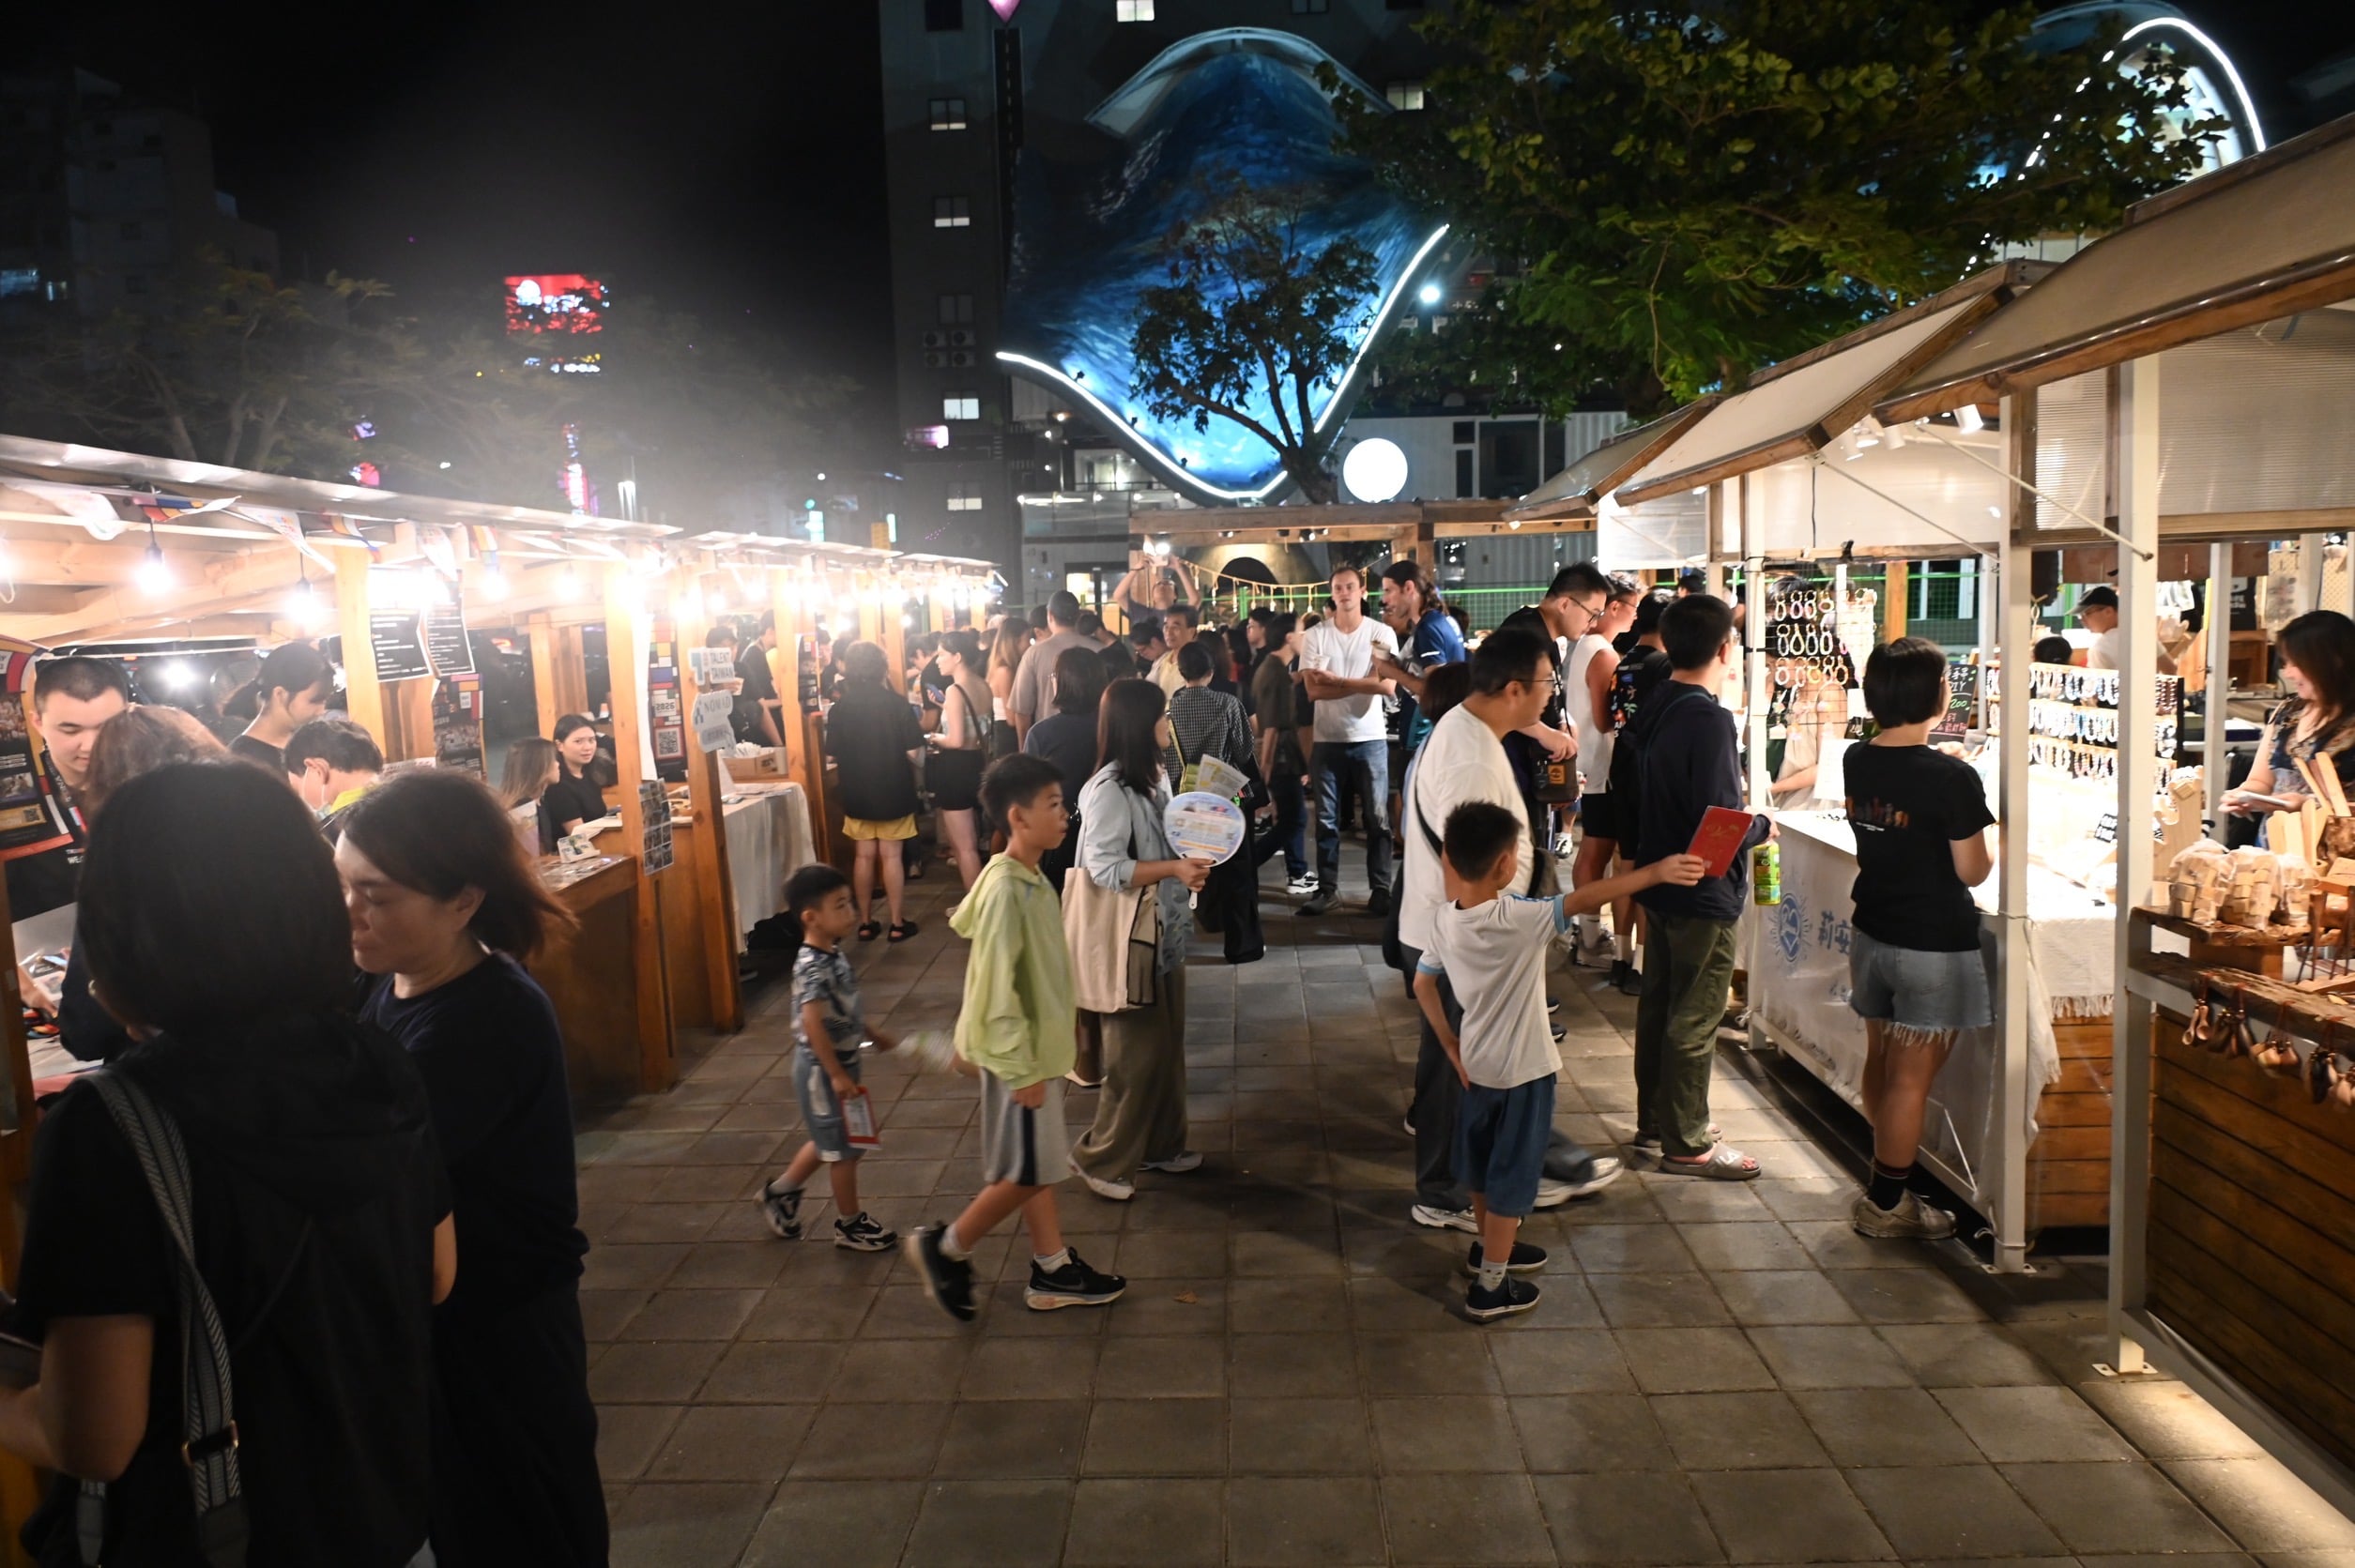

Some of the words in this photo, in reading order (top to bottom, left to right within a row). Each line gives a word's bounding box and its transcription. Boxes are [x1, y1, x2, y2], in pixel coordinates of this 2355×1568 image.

[710, 651, 730, 664] TALENT
[711, 666, 734, 680] TAIWAN
[704, 695, 731, 713] NOMAD
